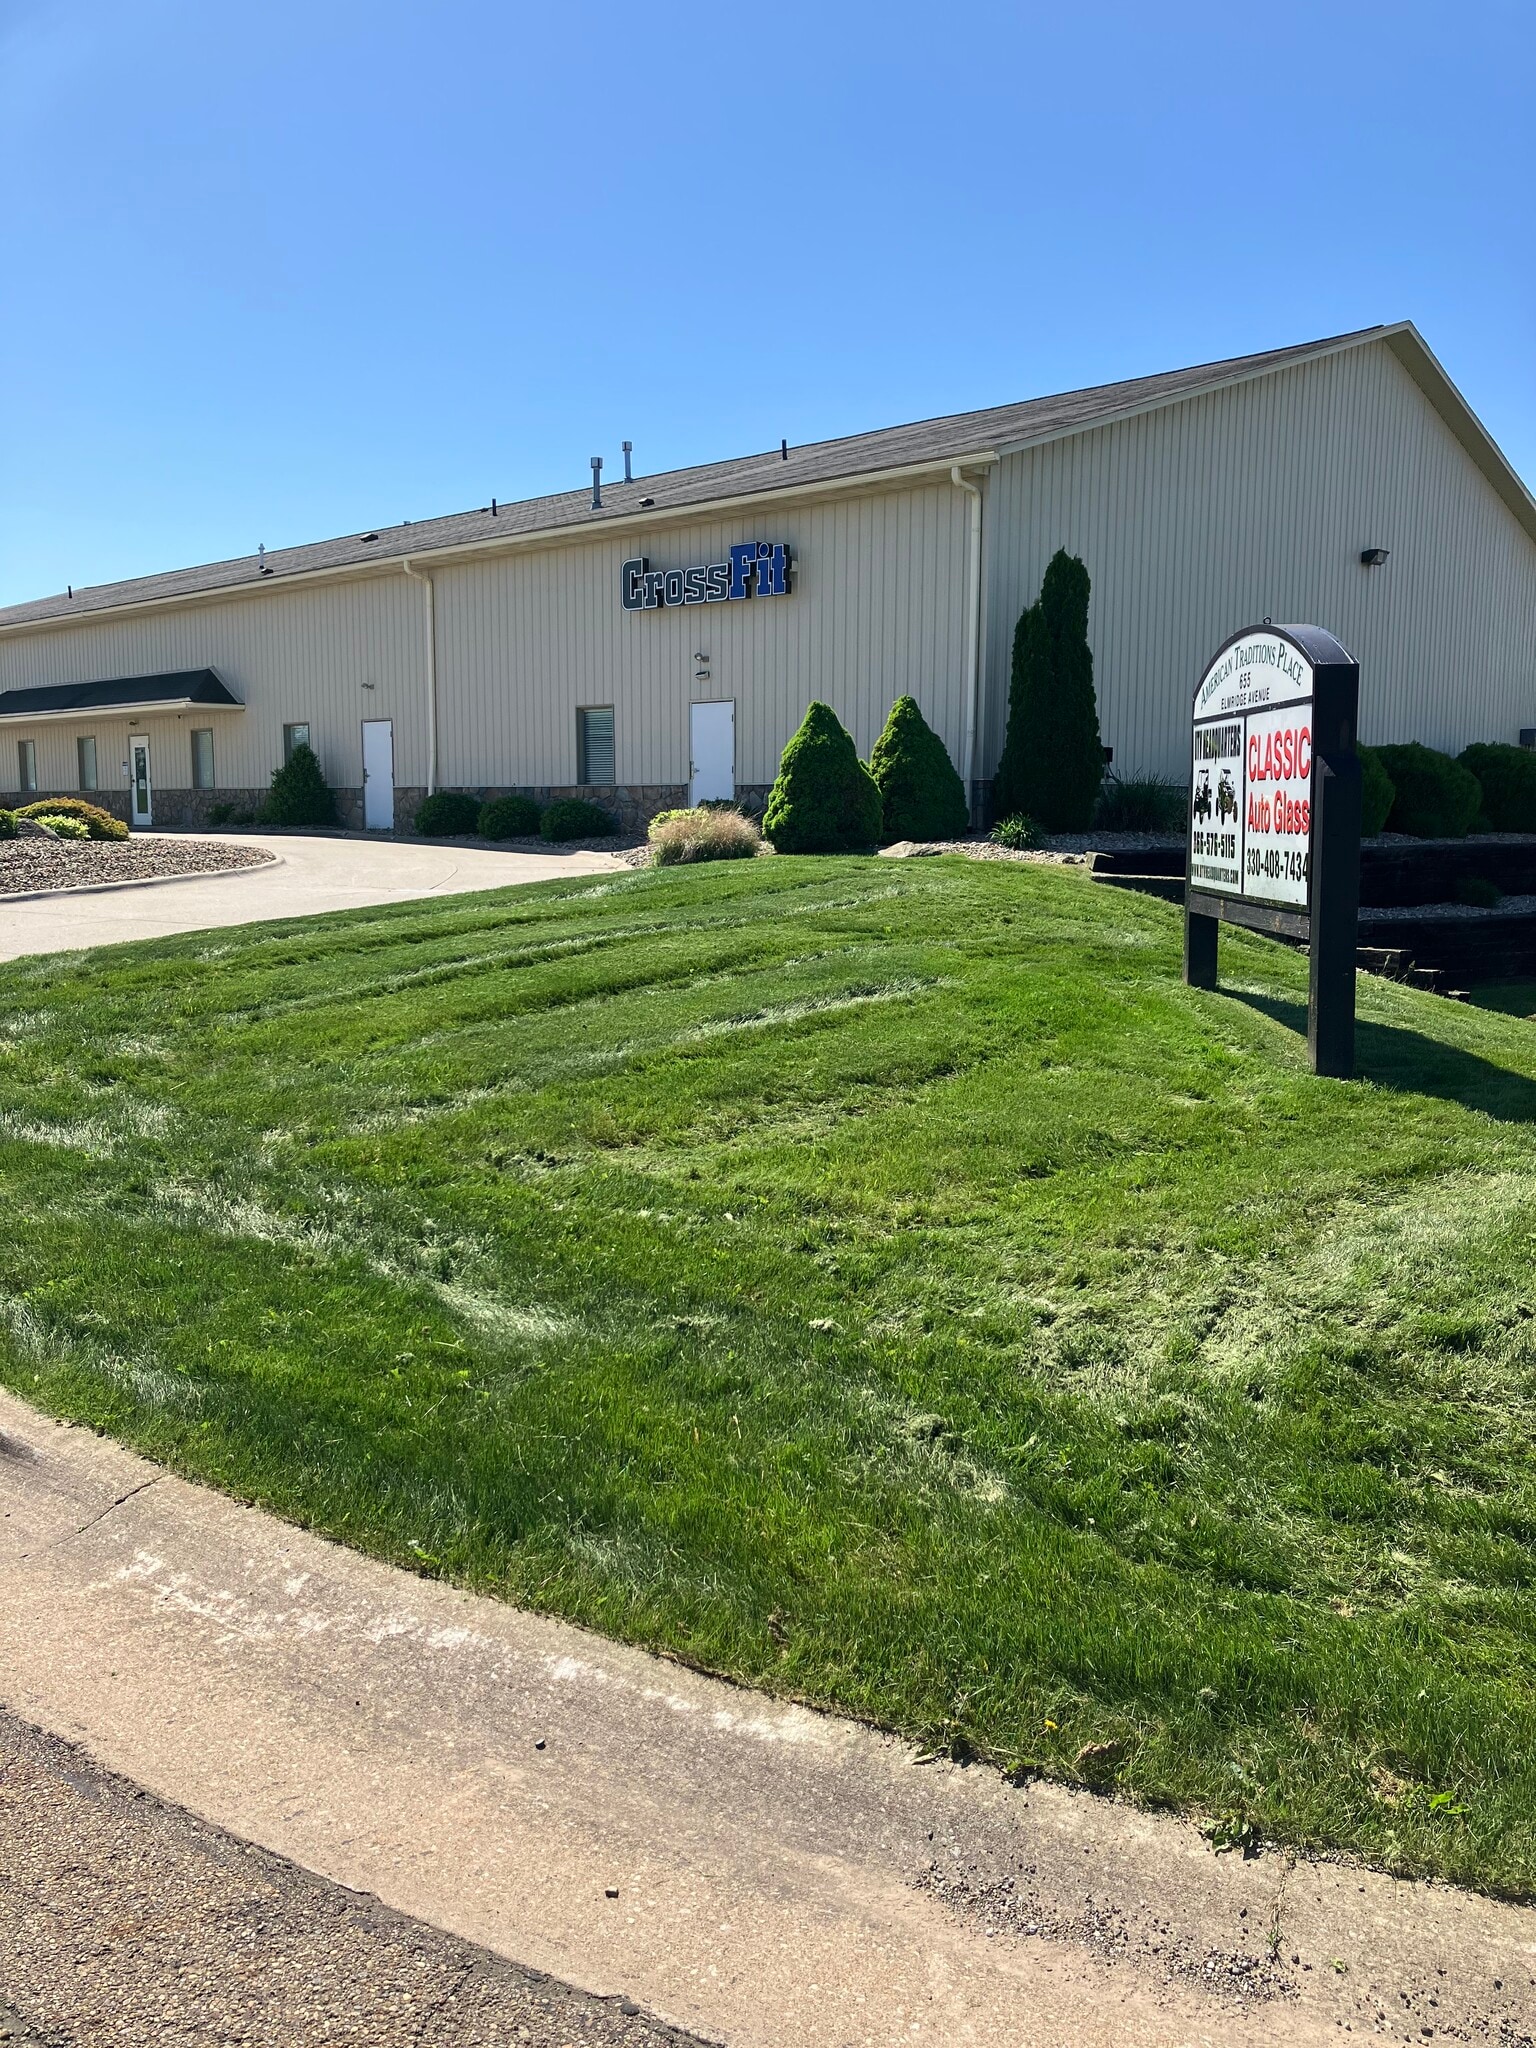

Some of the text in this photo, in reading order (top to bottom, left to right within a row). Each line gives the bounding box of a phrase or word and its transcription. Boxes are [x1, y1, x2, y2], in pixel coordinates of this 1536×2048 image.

[621, 541, 789, 611] CrossFit
[1200, 642, 1304, 710] AMERICAN TRADITIONS PLACE
[1239, 671, 1251, 690] 655
[1247, 687, 1270, 705] AVENUE
[1248, 726, 1311, 783] CLASSIC
[1247, 790, 1310, 836] Auto Glass
[1246, 847, 1308, 883] 330-408-7434
